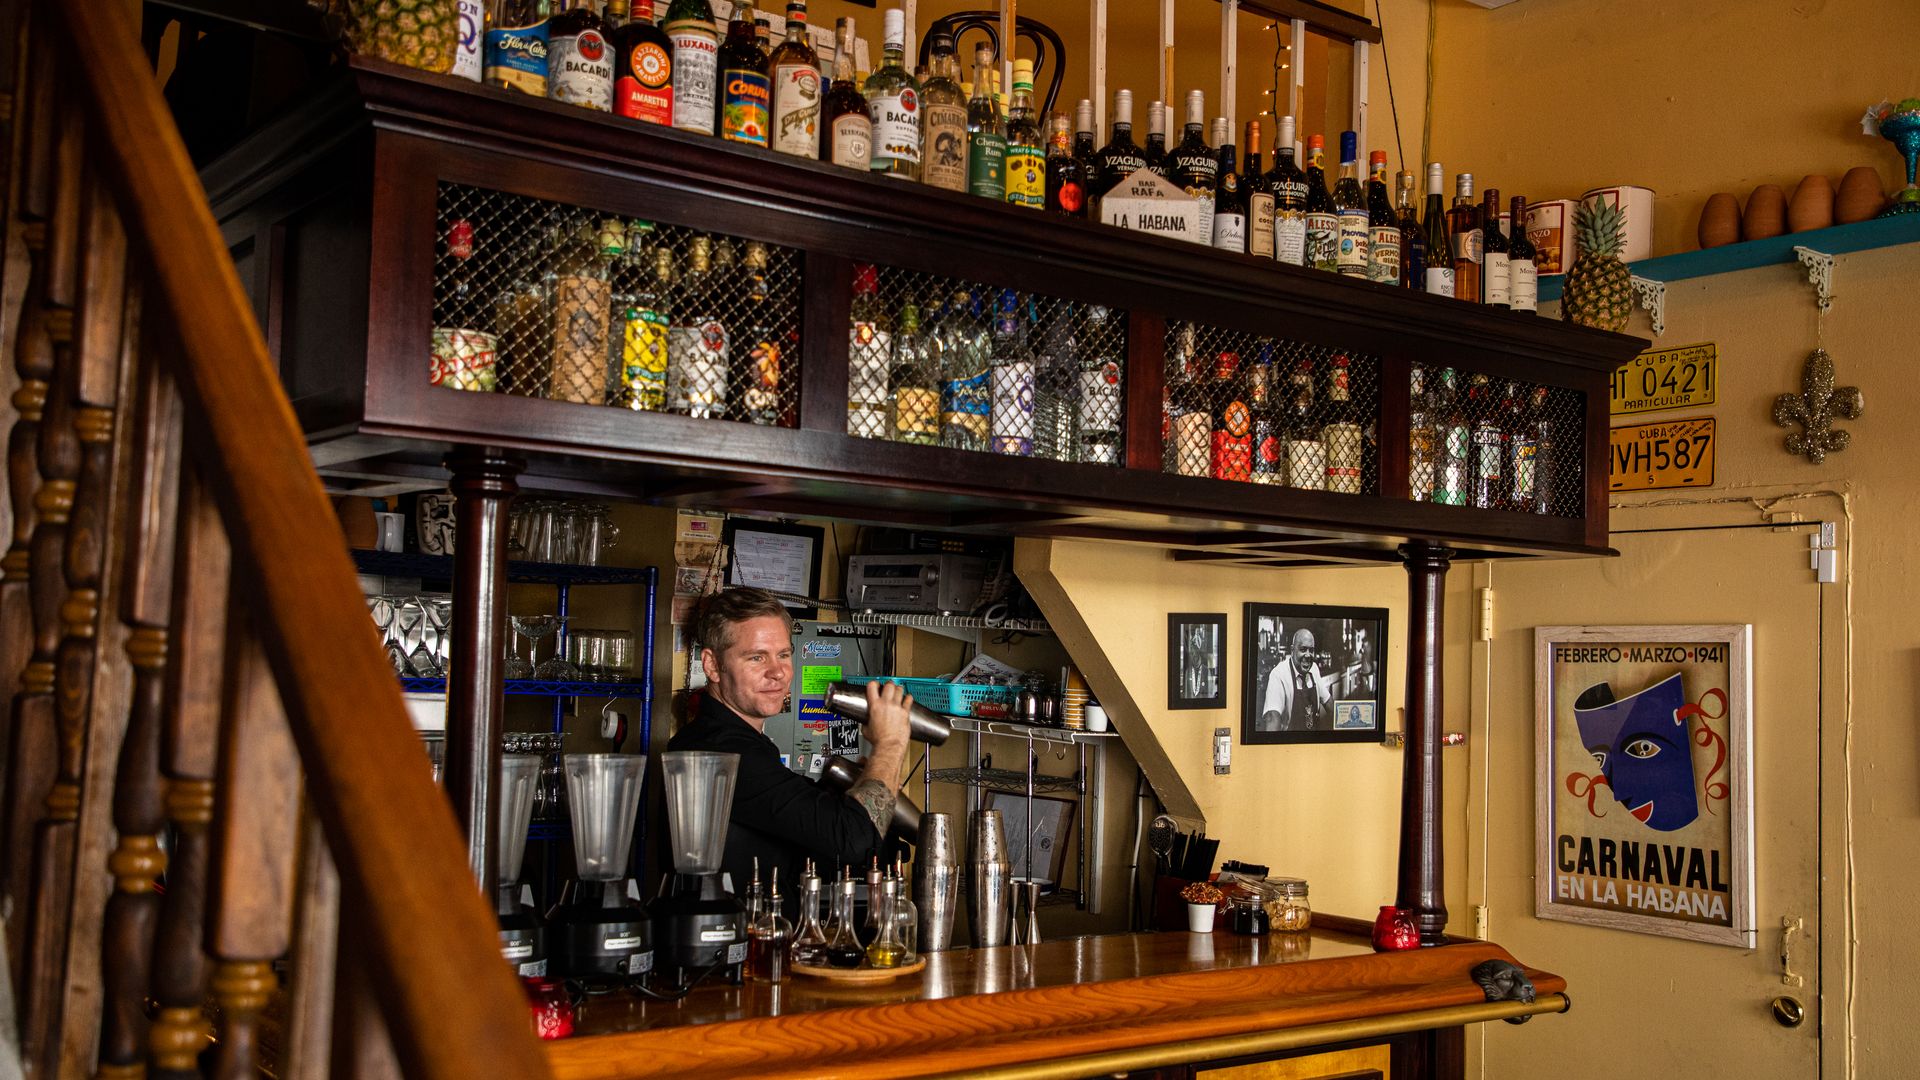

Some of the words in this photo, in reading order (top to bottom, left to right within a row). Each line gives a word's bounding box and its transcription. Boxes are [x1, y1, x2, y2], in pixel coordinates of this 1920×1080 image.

[457, 1, 479, 16] ON
[631, 91, 668, 108] AMARETTO
[1138, 180, 1156, 188] BAR
[1131, 187, 1165, 198] RAFA
[1138, 214, 1186, 232] HABANA
[1635, 352, 1679, 367] CUBA
[1642, 360, 1710, 398] 0421
[1623, 394, 1691, 410] PARTICULAR
[1639, 427, 1668, 440] CUBA
[1555, 647, 1622, 664] FEBRERO
[1629, 646, 1687, 664] MARZO
[1693, 646, 1724, 664] 1941
[980, 704, 1003, 712] BOLIVA
[1557, 834, 1728, 893] CARNAVAL
[1557, 875, 1586, 901] EN
[1592, 881, 1619, 905] LA
[1626, 884, 1728, 922] HABANA
